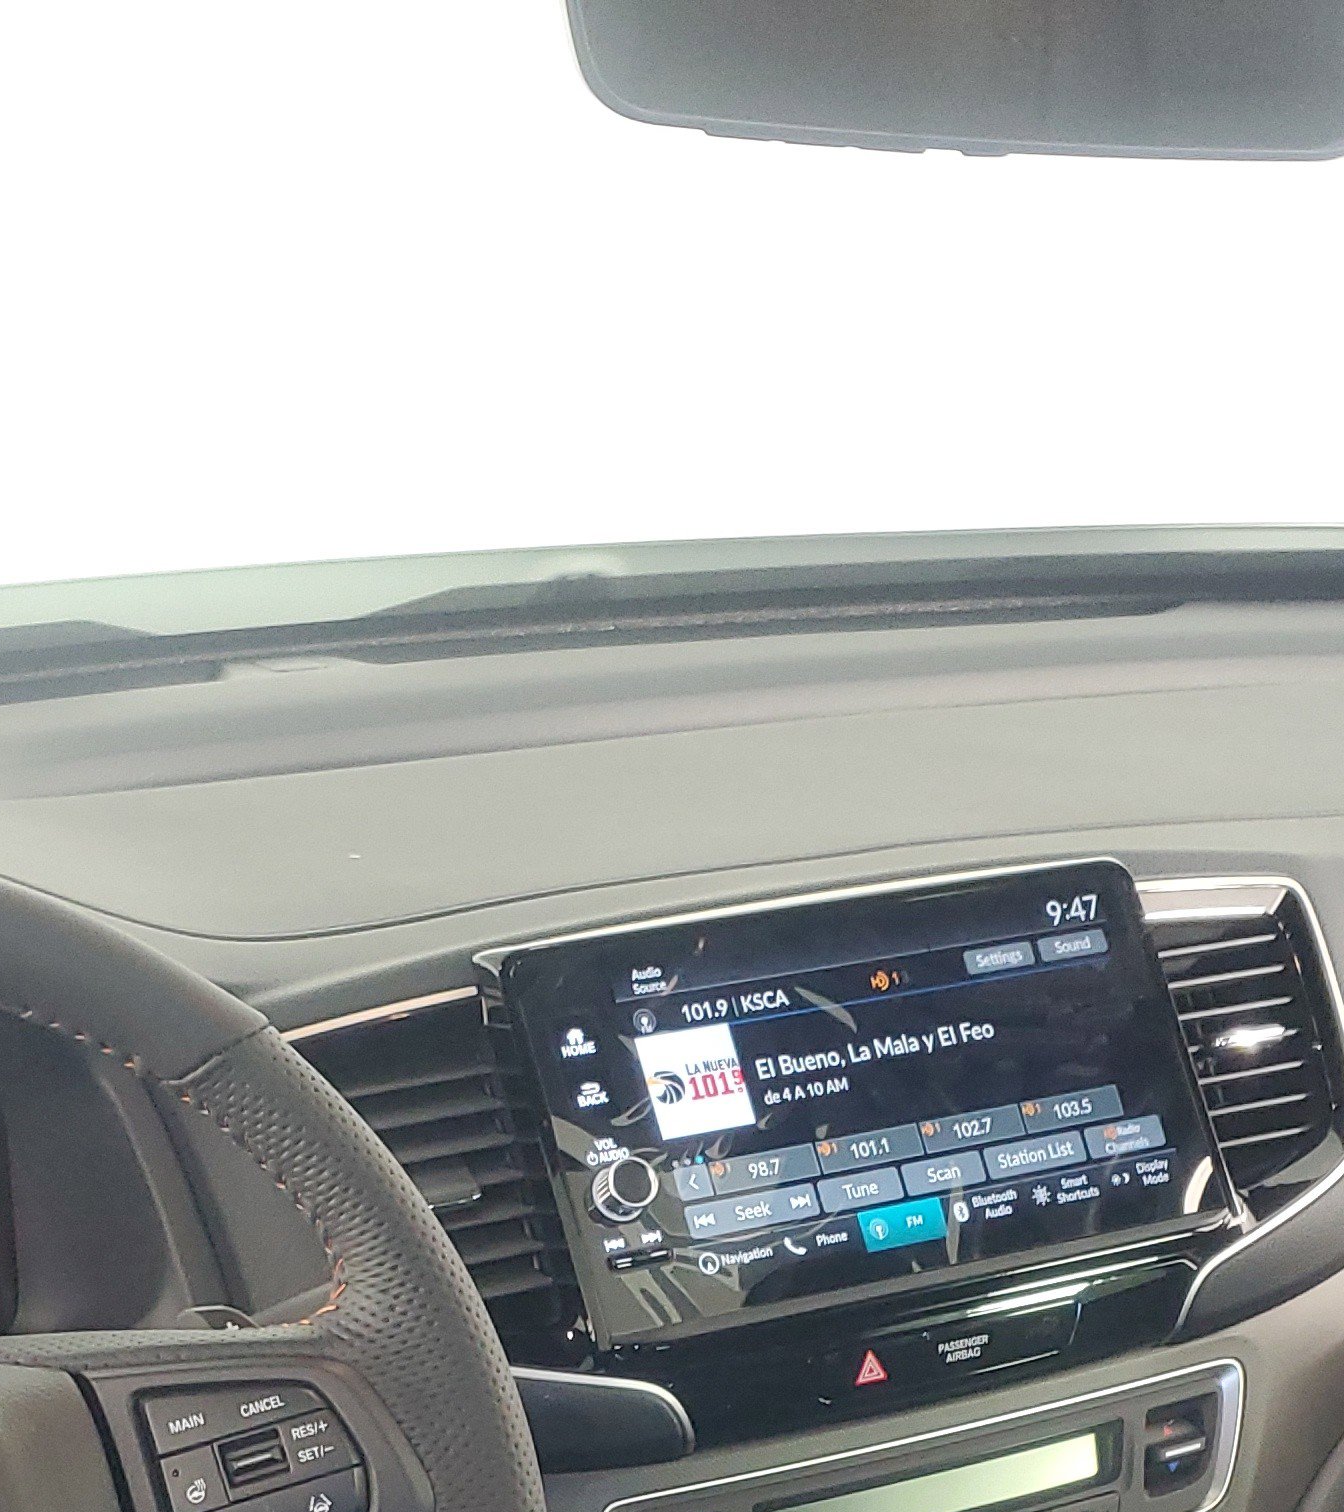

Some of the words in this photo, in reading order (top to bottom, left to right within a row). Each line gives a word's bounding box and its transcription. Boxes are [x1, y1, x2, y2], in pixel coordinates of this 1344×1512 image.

[1046, 894, 1098, 926] 9:47
[1054, 936, 1091, 954] Sound
[976, 950, 1022, 969] Settings
[632, 966, 662, 981] Audio
[632, 981, 666, 995] Source
[681, 999, 729, 1023] 101.9
[740, 990, 790, 1013] KSCA
[561, 1041, 597, 1058] HOME
[755, 1058, 774, 1080] El
[780, 1047, 847, 1076] Bueno,
[848, 1043, 871, 1064] La
[873, 1034, 919, 1060] Mala
[922, 1035, 935, 1054] y
[937, 1026, 957, 1047] El
[959, 1020, 995, 1043] Feo
[685, 1063, 701, 1076] LA
[702, 1058, 738, 1073] NUEVA
[577, 1091, 609, 1108] BACK
[763, 1089, 781, 1105] de
[782, 1086, 792, 1101] 4
[794, 1085, 805, 1099] A
[807, 1081, 824, 1097] 10
[826, 1077, 849, 1093] AM
[1053, 1098, 1093, 1120] 103.5
[953, 1117, 992, 1139] 102.7
[593, 1138, 617, 1150] VOL
[850, 1138, 890, 1159] 101.1
[599, 1147, 630, 1163] AUDIO
[998, 1148, 1047, 1170] Station
[1048, 1141, 1074, 1158] List
[748, 1159, 779, 1178] 98.7
[927, 1165, 961, 1183] Scan
[1135, 1158, 1169, 1176] Display
[1061, 1174, 1088, 1189] Smart
[1142, 1172, 1170, 1187] Mode
[842, 1182, 879, 1200] Tune
[971, 1189, 1018, 1208] Bluetooth
[1056, 1186, 1100, 1206] Shortcuts
[735, 1202, 772, 1221] Seek
[906, 1214, 924, 1228] FM
[985, 1206, 1013, 1220] Audio
[816, 1231, 848, 1247] Phone
[721, 1246, 773, 1268] Navigation
[938, 1334, 989, 1355] PASSENGER
[945, 1346, 981, 1363] AIRBAG
[240, 1394, 285, 1418] CANCEL
[167, 1412, 205, 1435] MAIN
[291, 1420, 328, 1440] RES/+
